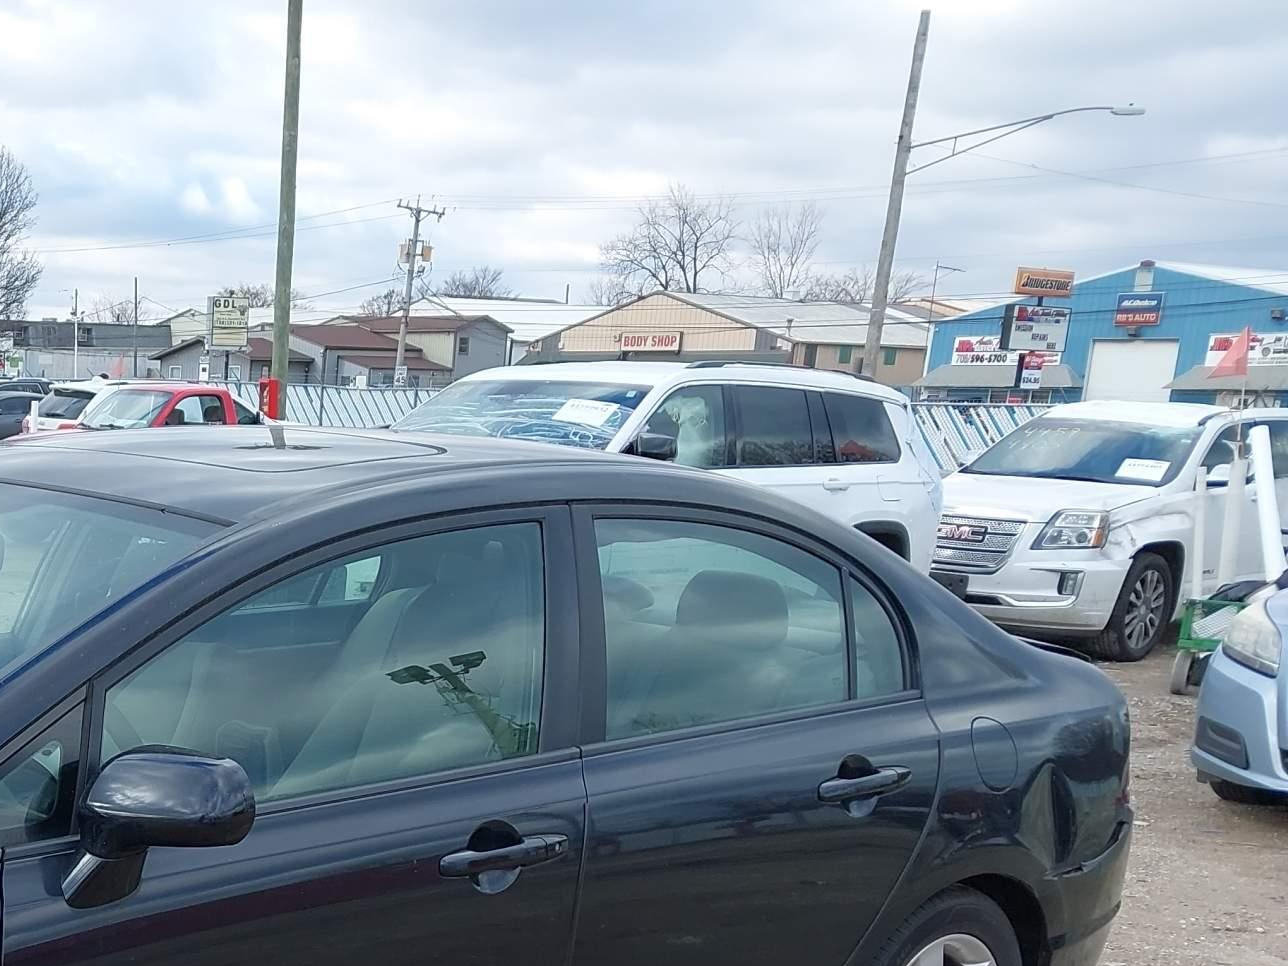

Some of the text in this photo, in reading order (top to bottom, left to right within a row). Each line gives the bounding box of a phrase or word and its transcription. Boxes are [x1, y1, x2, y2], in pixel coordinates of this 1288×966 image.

[214, 299, 237, 309] GDL
[1134, 313, 1156, 321] AUTO
[623, 335, 677, 347] BODY SHOP
[936, 524, 985, 541] GMC
